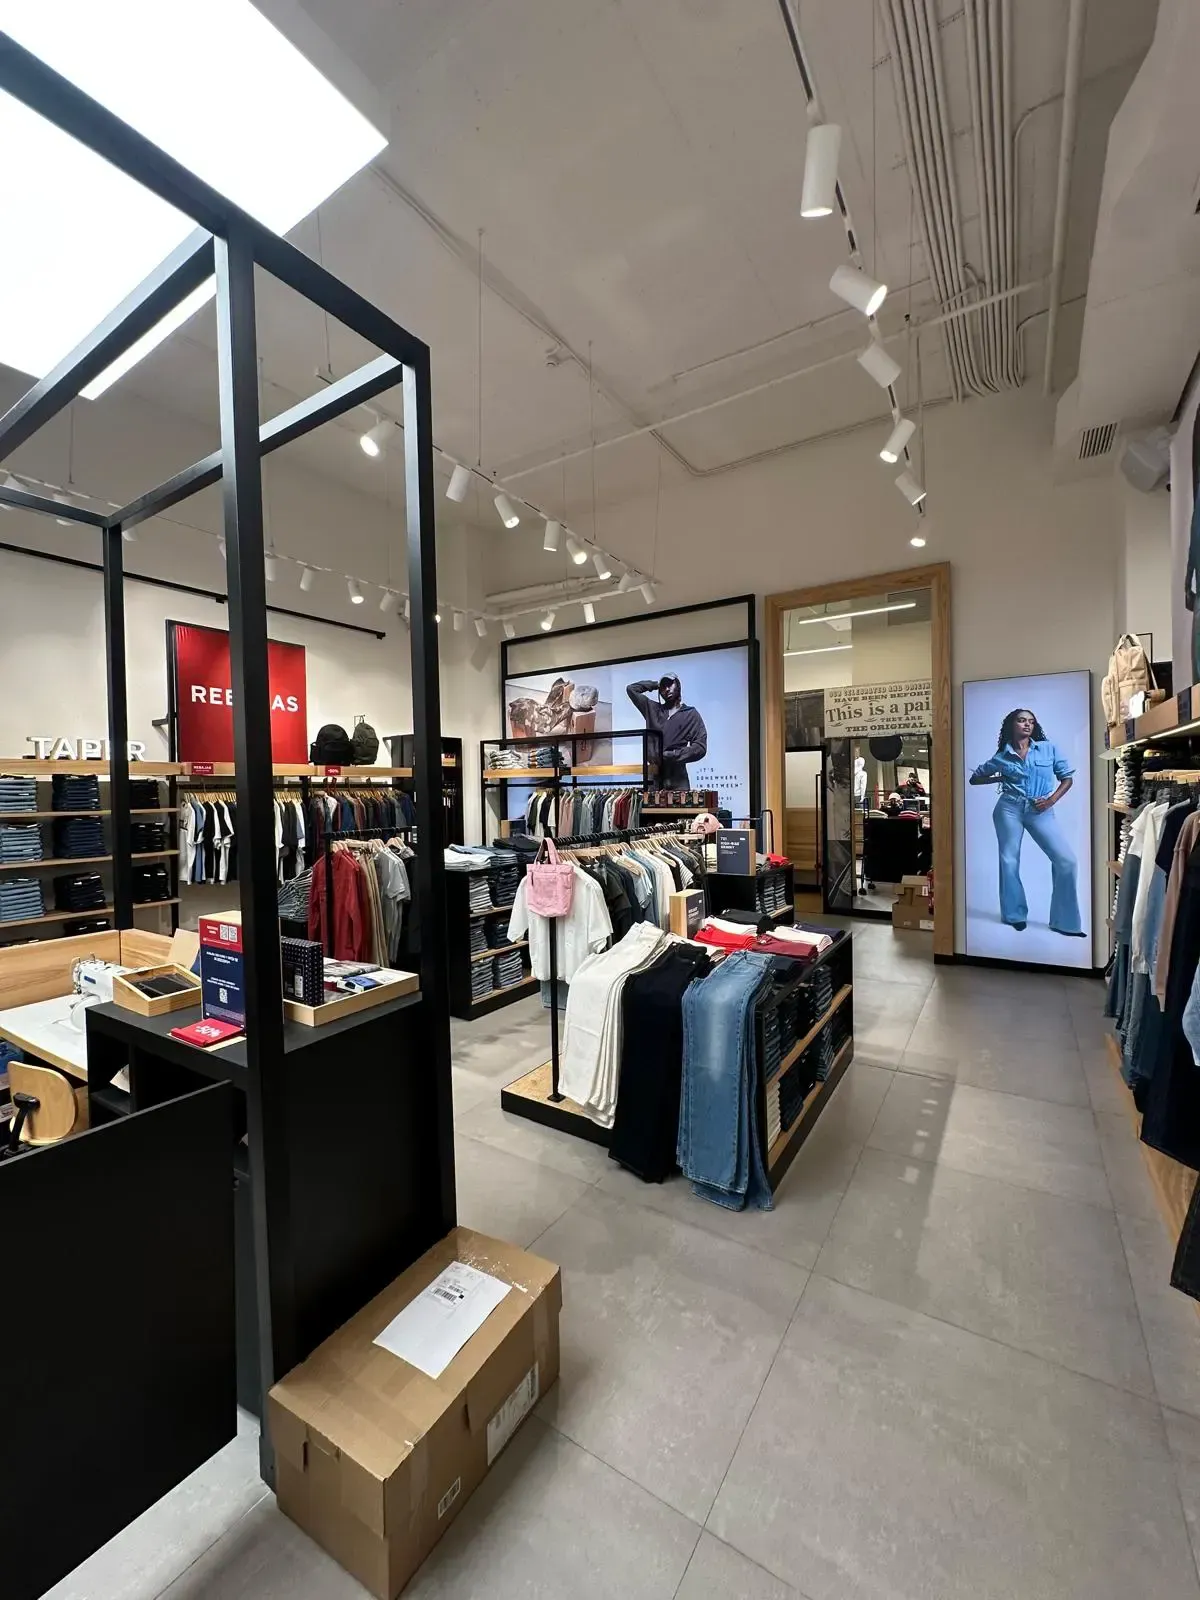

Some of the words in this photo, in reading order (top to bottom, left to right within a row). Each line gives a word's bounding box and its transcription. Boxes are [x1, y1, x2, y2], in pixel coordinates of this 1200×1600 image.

[191, 685, 299, 712] REAS
[834, 694, 860, 703] HAVE
[890, 690, 931, 699] BEFORE
[826, 705, 863, 722] This
[869, 702, 885, 716] is
[889, 703, 899, 714] a
[870, 722, 927, 731] ORIGINAL
[27, 736, 146, 761] TAPR
